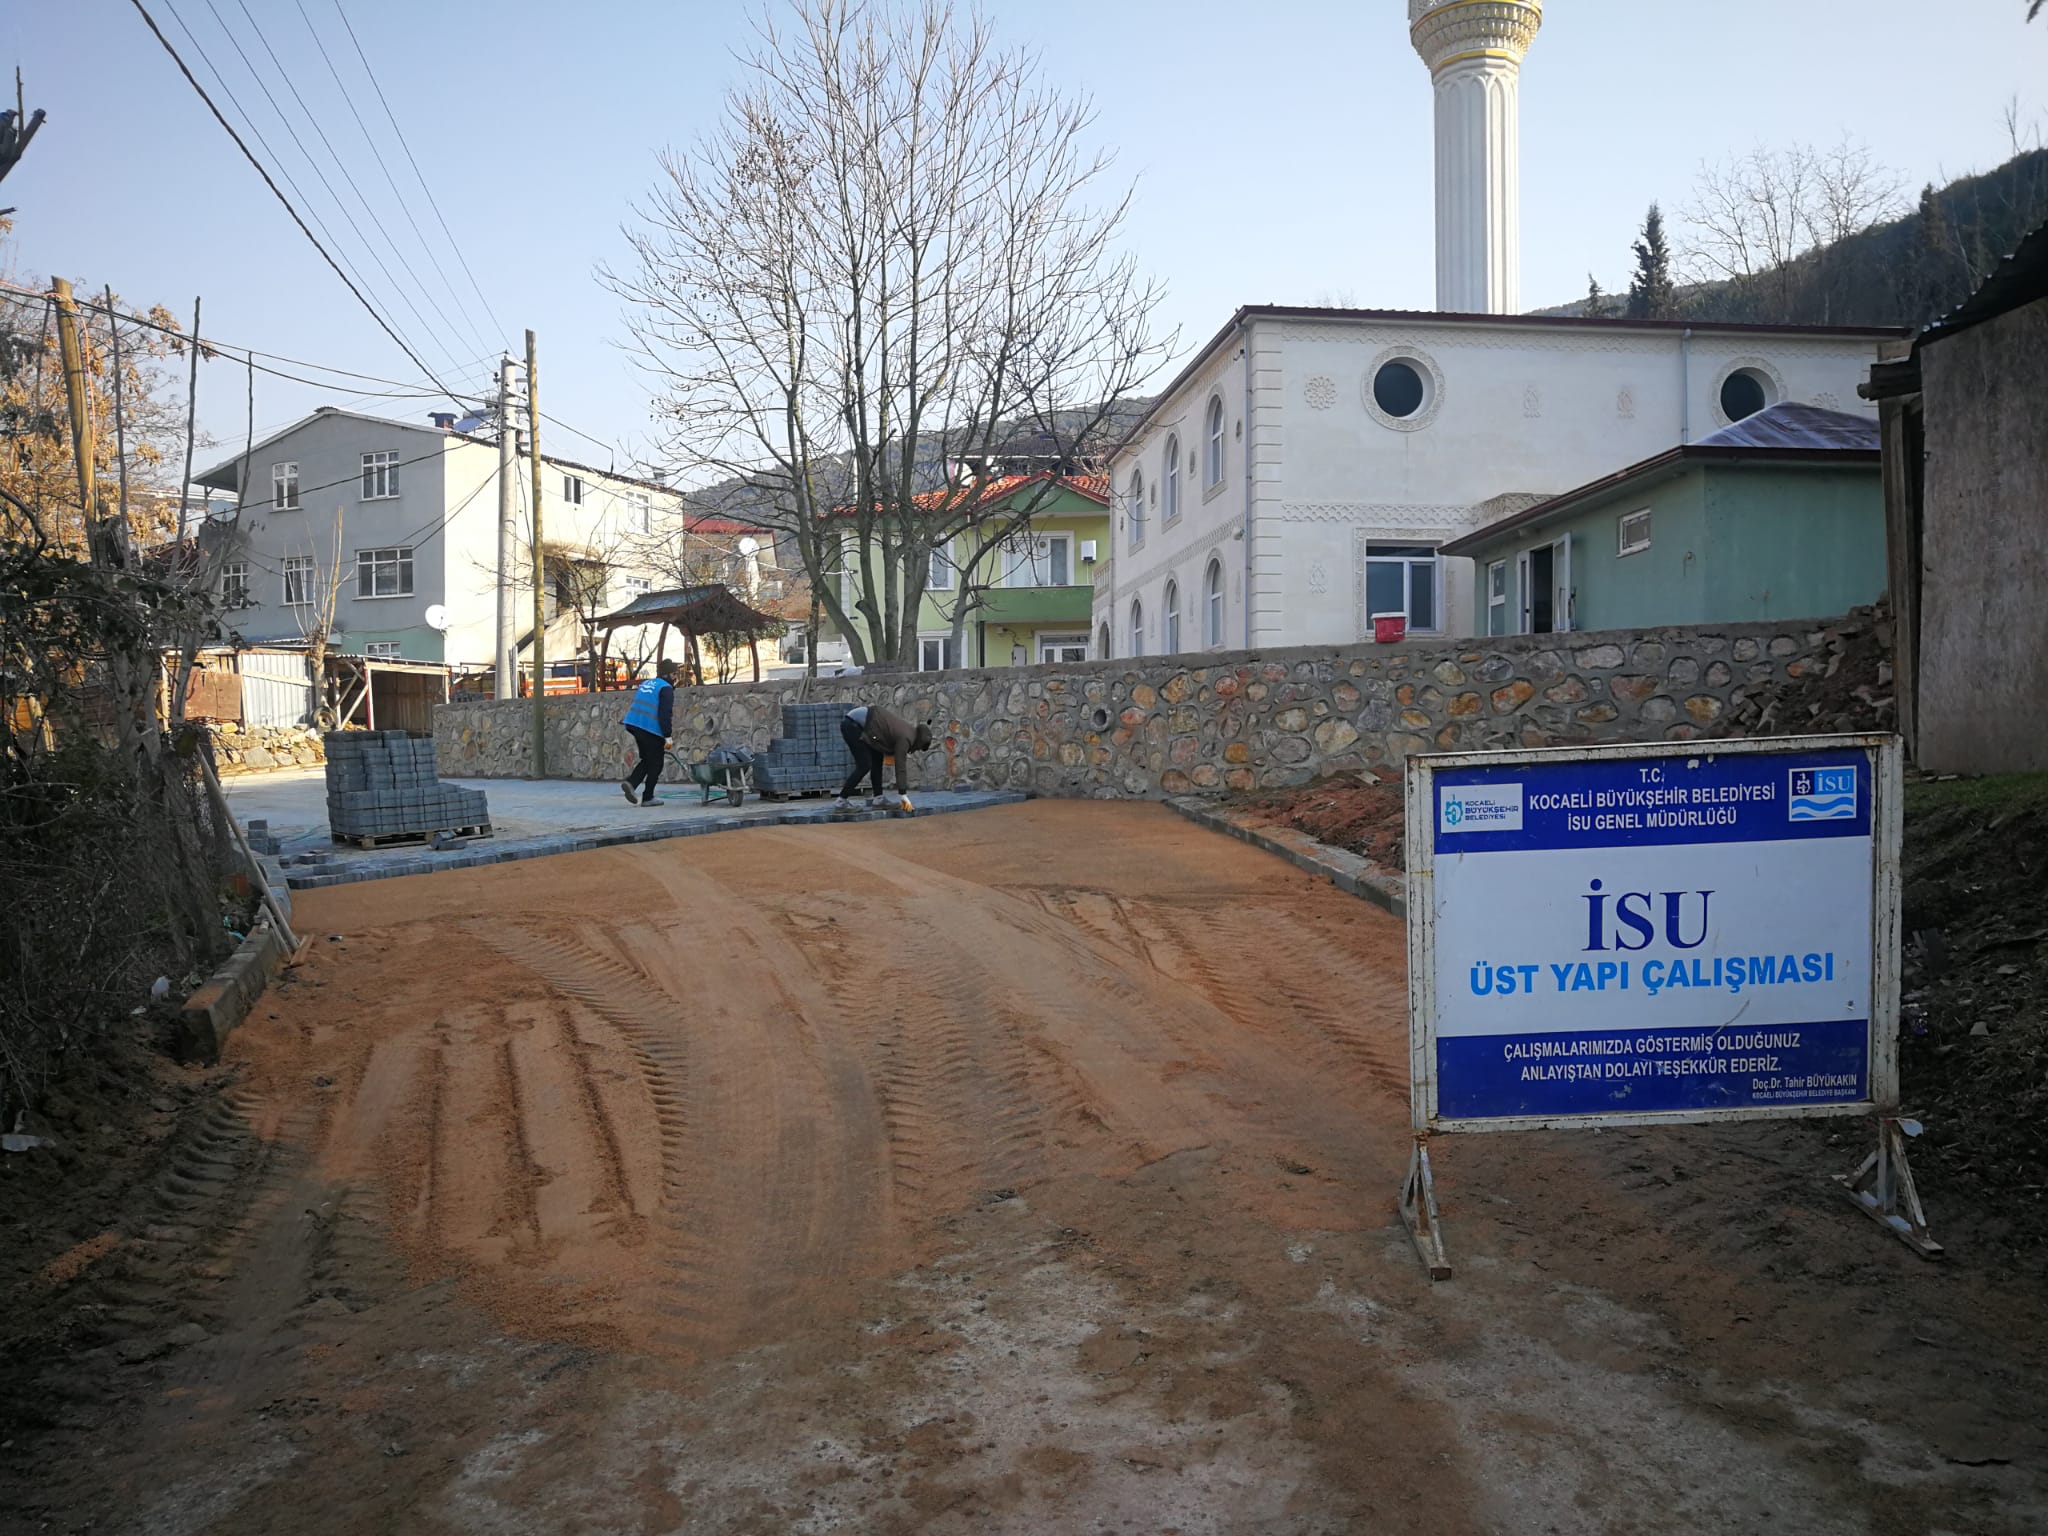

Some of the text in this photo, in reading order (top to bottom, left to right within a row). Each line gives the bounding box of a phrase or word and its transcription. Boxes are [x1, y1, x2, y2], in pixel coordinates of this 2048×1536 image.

[1529, 782, 1776, 810] KOCAELİ BÜYÜKŞEHİR BELEDİYESİ
[1818, 773, 1851, 792] İSU
[1464, 805, 1519, 814] BÜYÜKŞEHİR
[1567, 806, 1737, 831] İSU GENEL MÜDÜRLÜĞÜ
[1581, 878, 1716, 952] İSU
[1470, 952, 1834, 997] ÜST YAPI ÇALIŞMASI
[1504, 1031, 1801, 1063] ÇALIŞMALARIMIZDA GÖSTERMİŞ OLDUĞUNUZ
[1520, 1053, 1782, 1083] ANLAYIŞTAN DOLAYI TEŞEKKÜR EDERİZ.
[1784, 1075, 1806, 1088] Tahir
[1806, 1073, 1857, 1088] BÜYÜKAKIN
